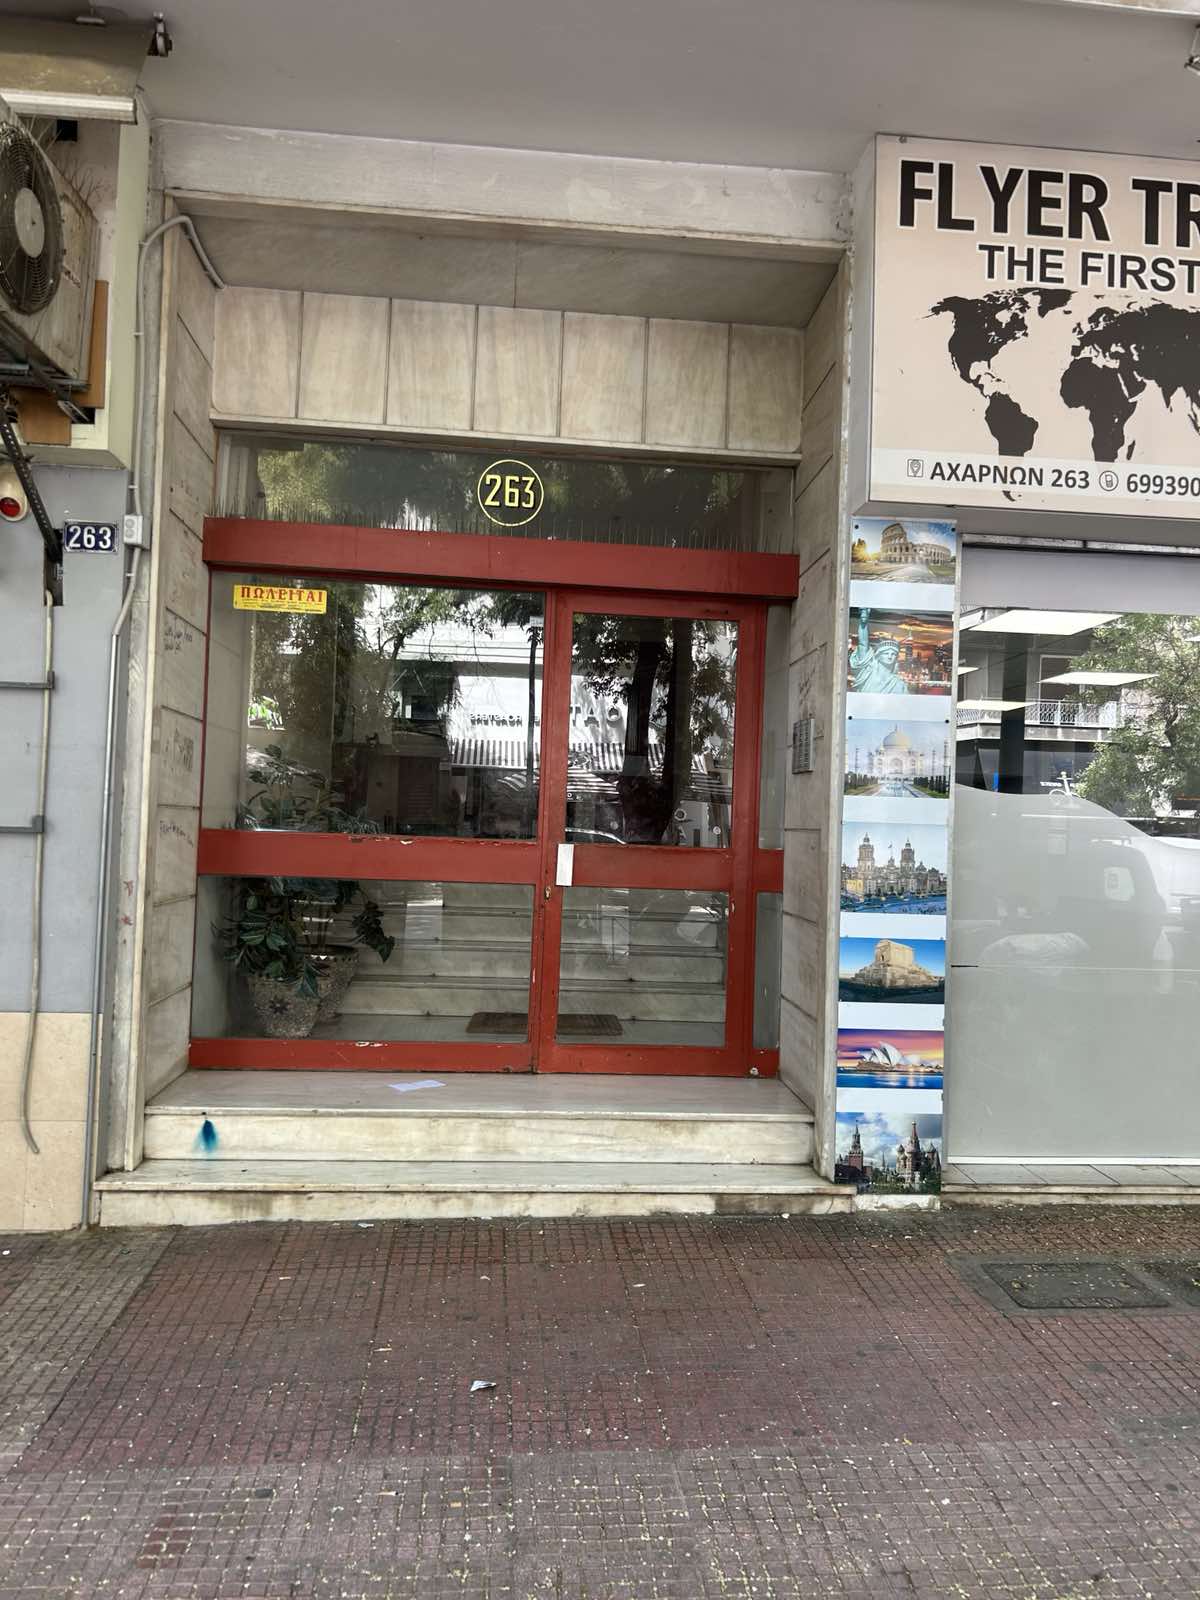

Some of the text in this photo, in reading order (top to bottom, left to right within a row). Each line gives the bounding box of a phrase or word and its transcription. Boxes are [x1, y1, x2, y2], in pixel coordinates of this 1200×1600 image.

[899, 160, 1111, 241] FLYER
[978, 244, 1200, 293] THE FIRST
[930, 462, 1089, 489] ΑΧΑΡΝΩΝ 263
[1126, 474, 1200, 496] 699390
[484, 474, 535, 508] 263
[68, 525, 112, 549] 263
[240, 586, 324, 602] ΠΩΛΕΙΤΑΙ
